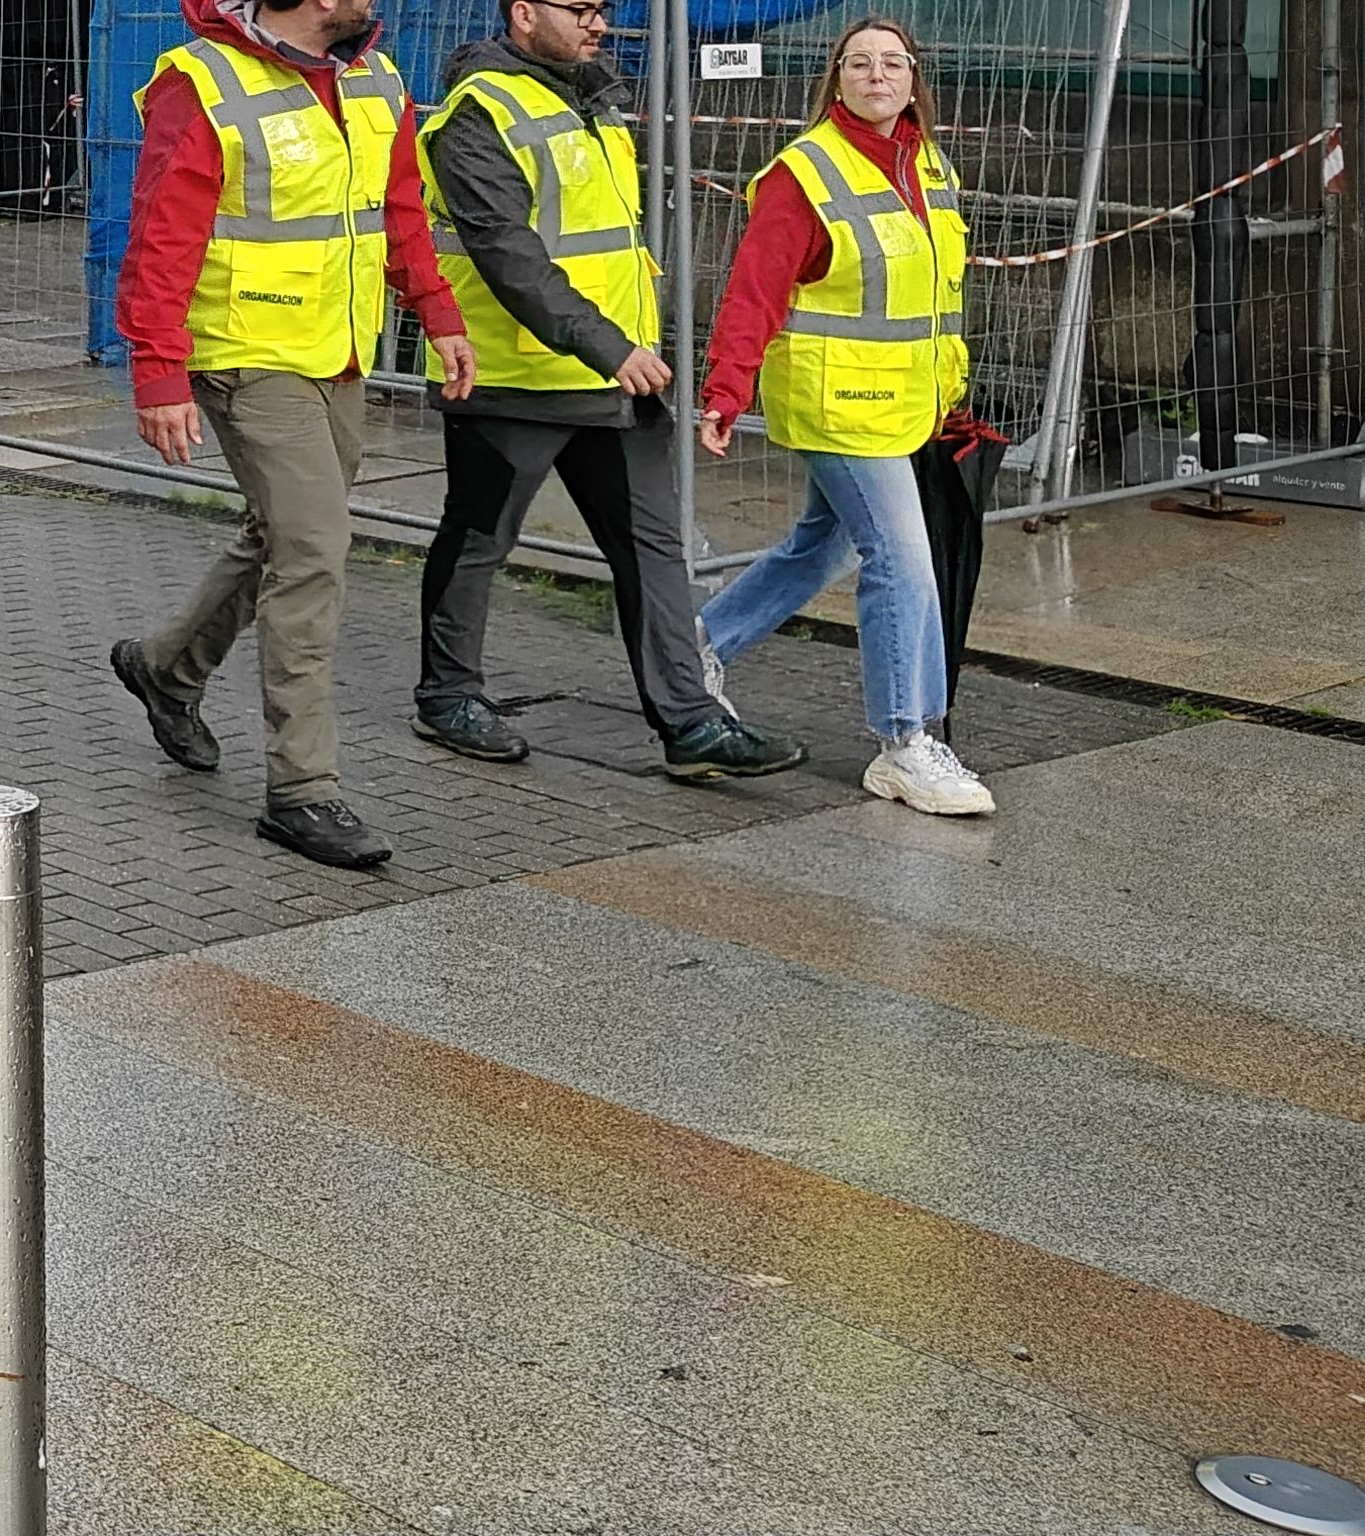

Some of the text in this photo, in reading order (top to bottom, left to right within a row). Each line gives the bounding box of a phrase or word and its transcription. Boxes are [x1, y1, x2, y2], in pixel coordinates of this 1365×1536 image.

[238, 290, 304, 306] ORGANIZACION
[834, 389, 896, 401] ORGANIZACION
[1272, 474, 1309, 487] alquiler
